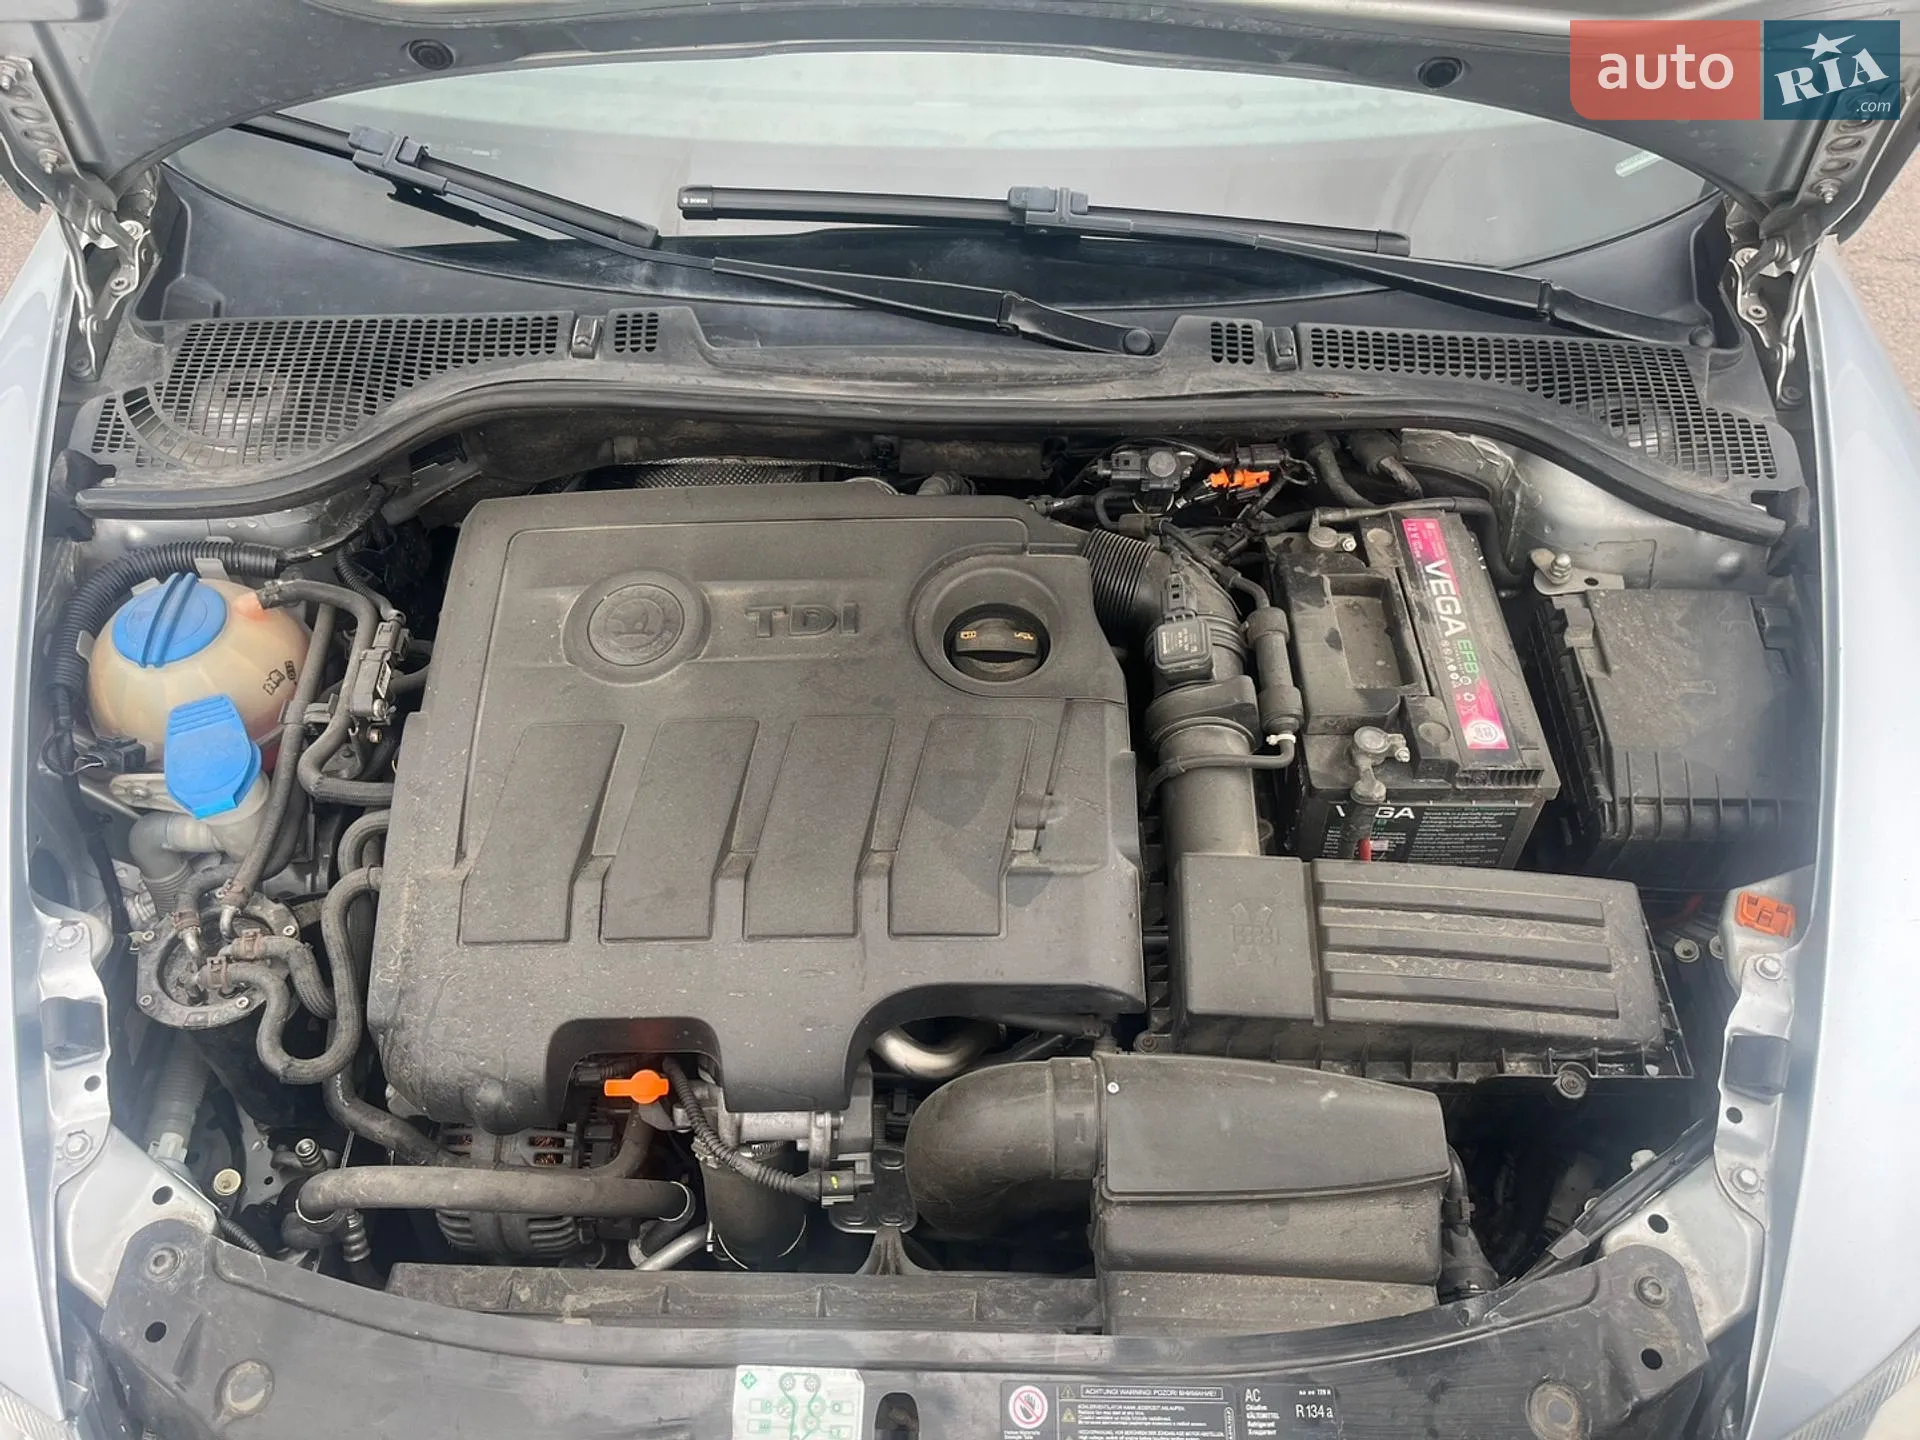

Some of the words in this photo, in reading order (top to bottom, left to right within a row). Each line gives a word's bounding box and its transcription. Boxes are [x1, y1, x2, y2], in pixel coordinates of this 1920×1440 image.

[744, 602, 860, 639] TDI
[1425, 558, 1467, 637] VEGA
[1457, 639, 1479, 675] EFB
[1245, 1388, 1262, 1403] AC
